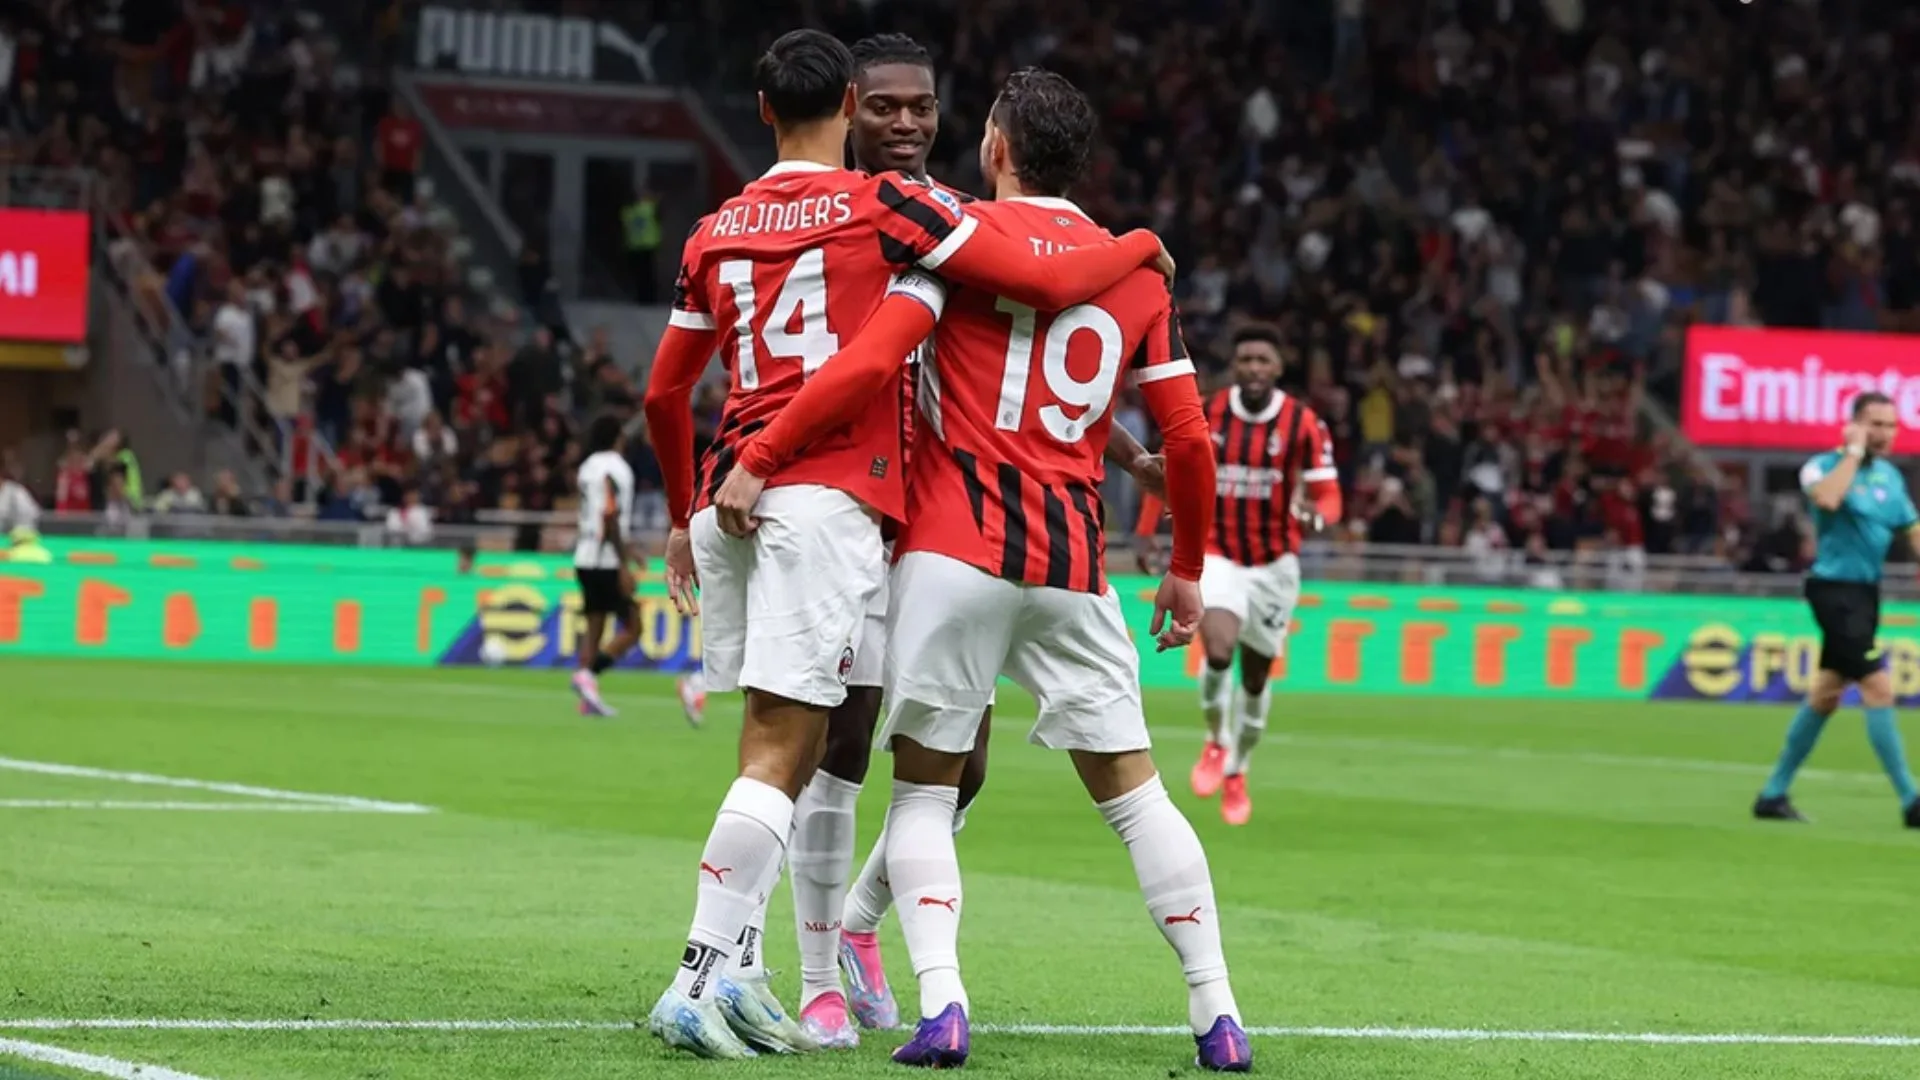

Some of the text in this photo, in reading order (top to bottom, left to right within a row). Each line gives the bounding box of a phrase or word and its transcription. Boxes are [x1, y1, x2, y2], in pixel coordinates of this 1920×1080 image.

[417, 7, 594, 78] PUMA
[711, 192, 852, 237] REIJNDERS
[718, 248, 839, 390] 14
[994, 294, 1124, 444] 19
